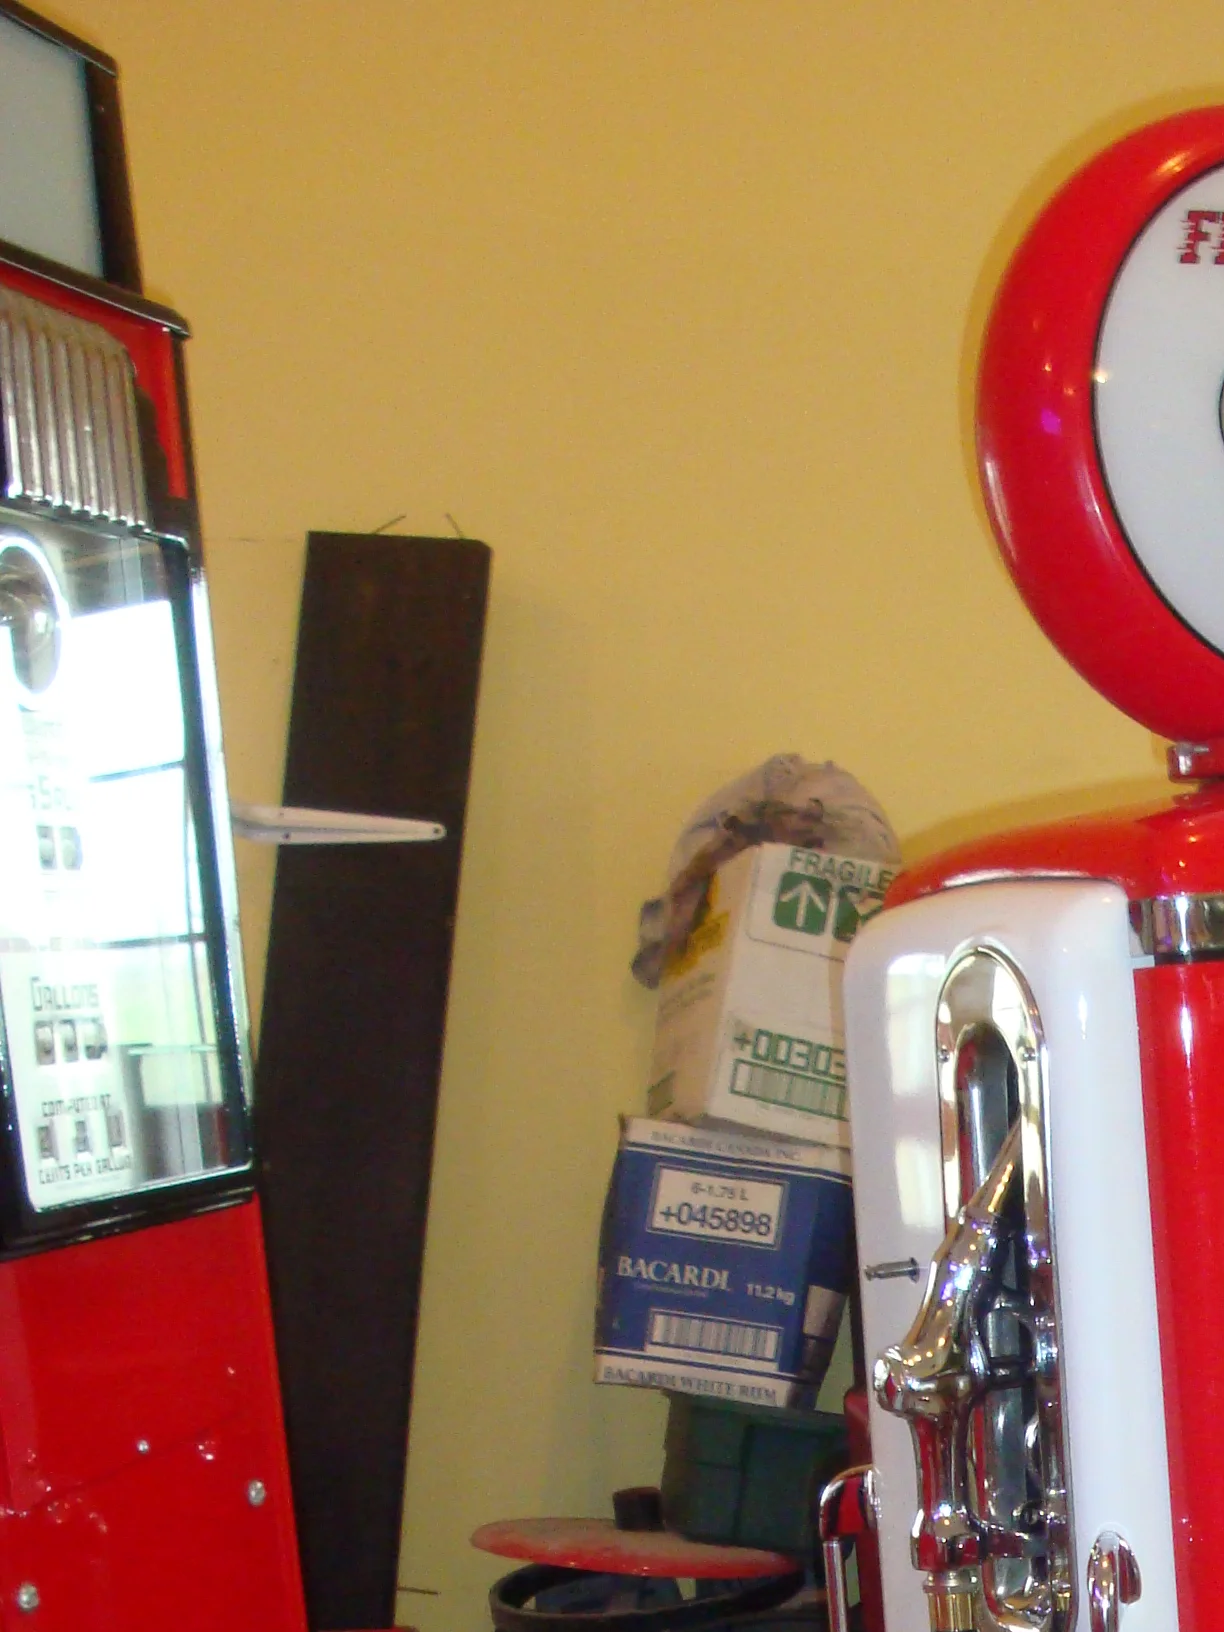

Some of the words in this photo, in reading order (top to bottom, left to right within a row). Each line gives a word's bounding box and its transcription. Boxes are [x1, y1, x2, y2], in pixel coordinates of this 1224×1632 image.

[788, 848, 893, 890] FRAGILE
[659, 1201, 772, 1236] +045898
[616, 1254, 731, 1291] BACARDI
